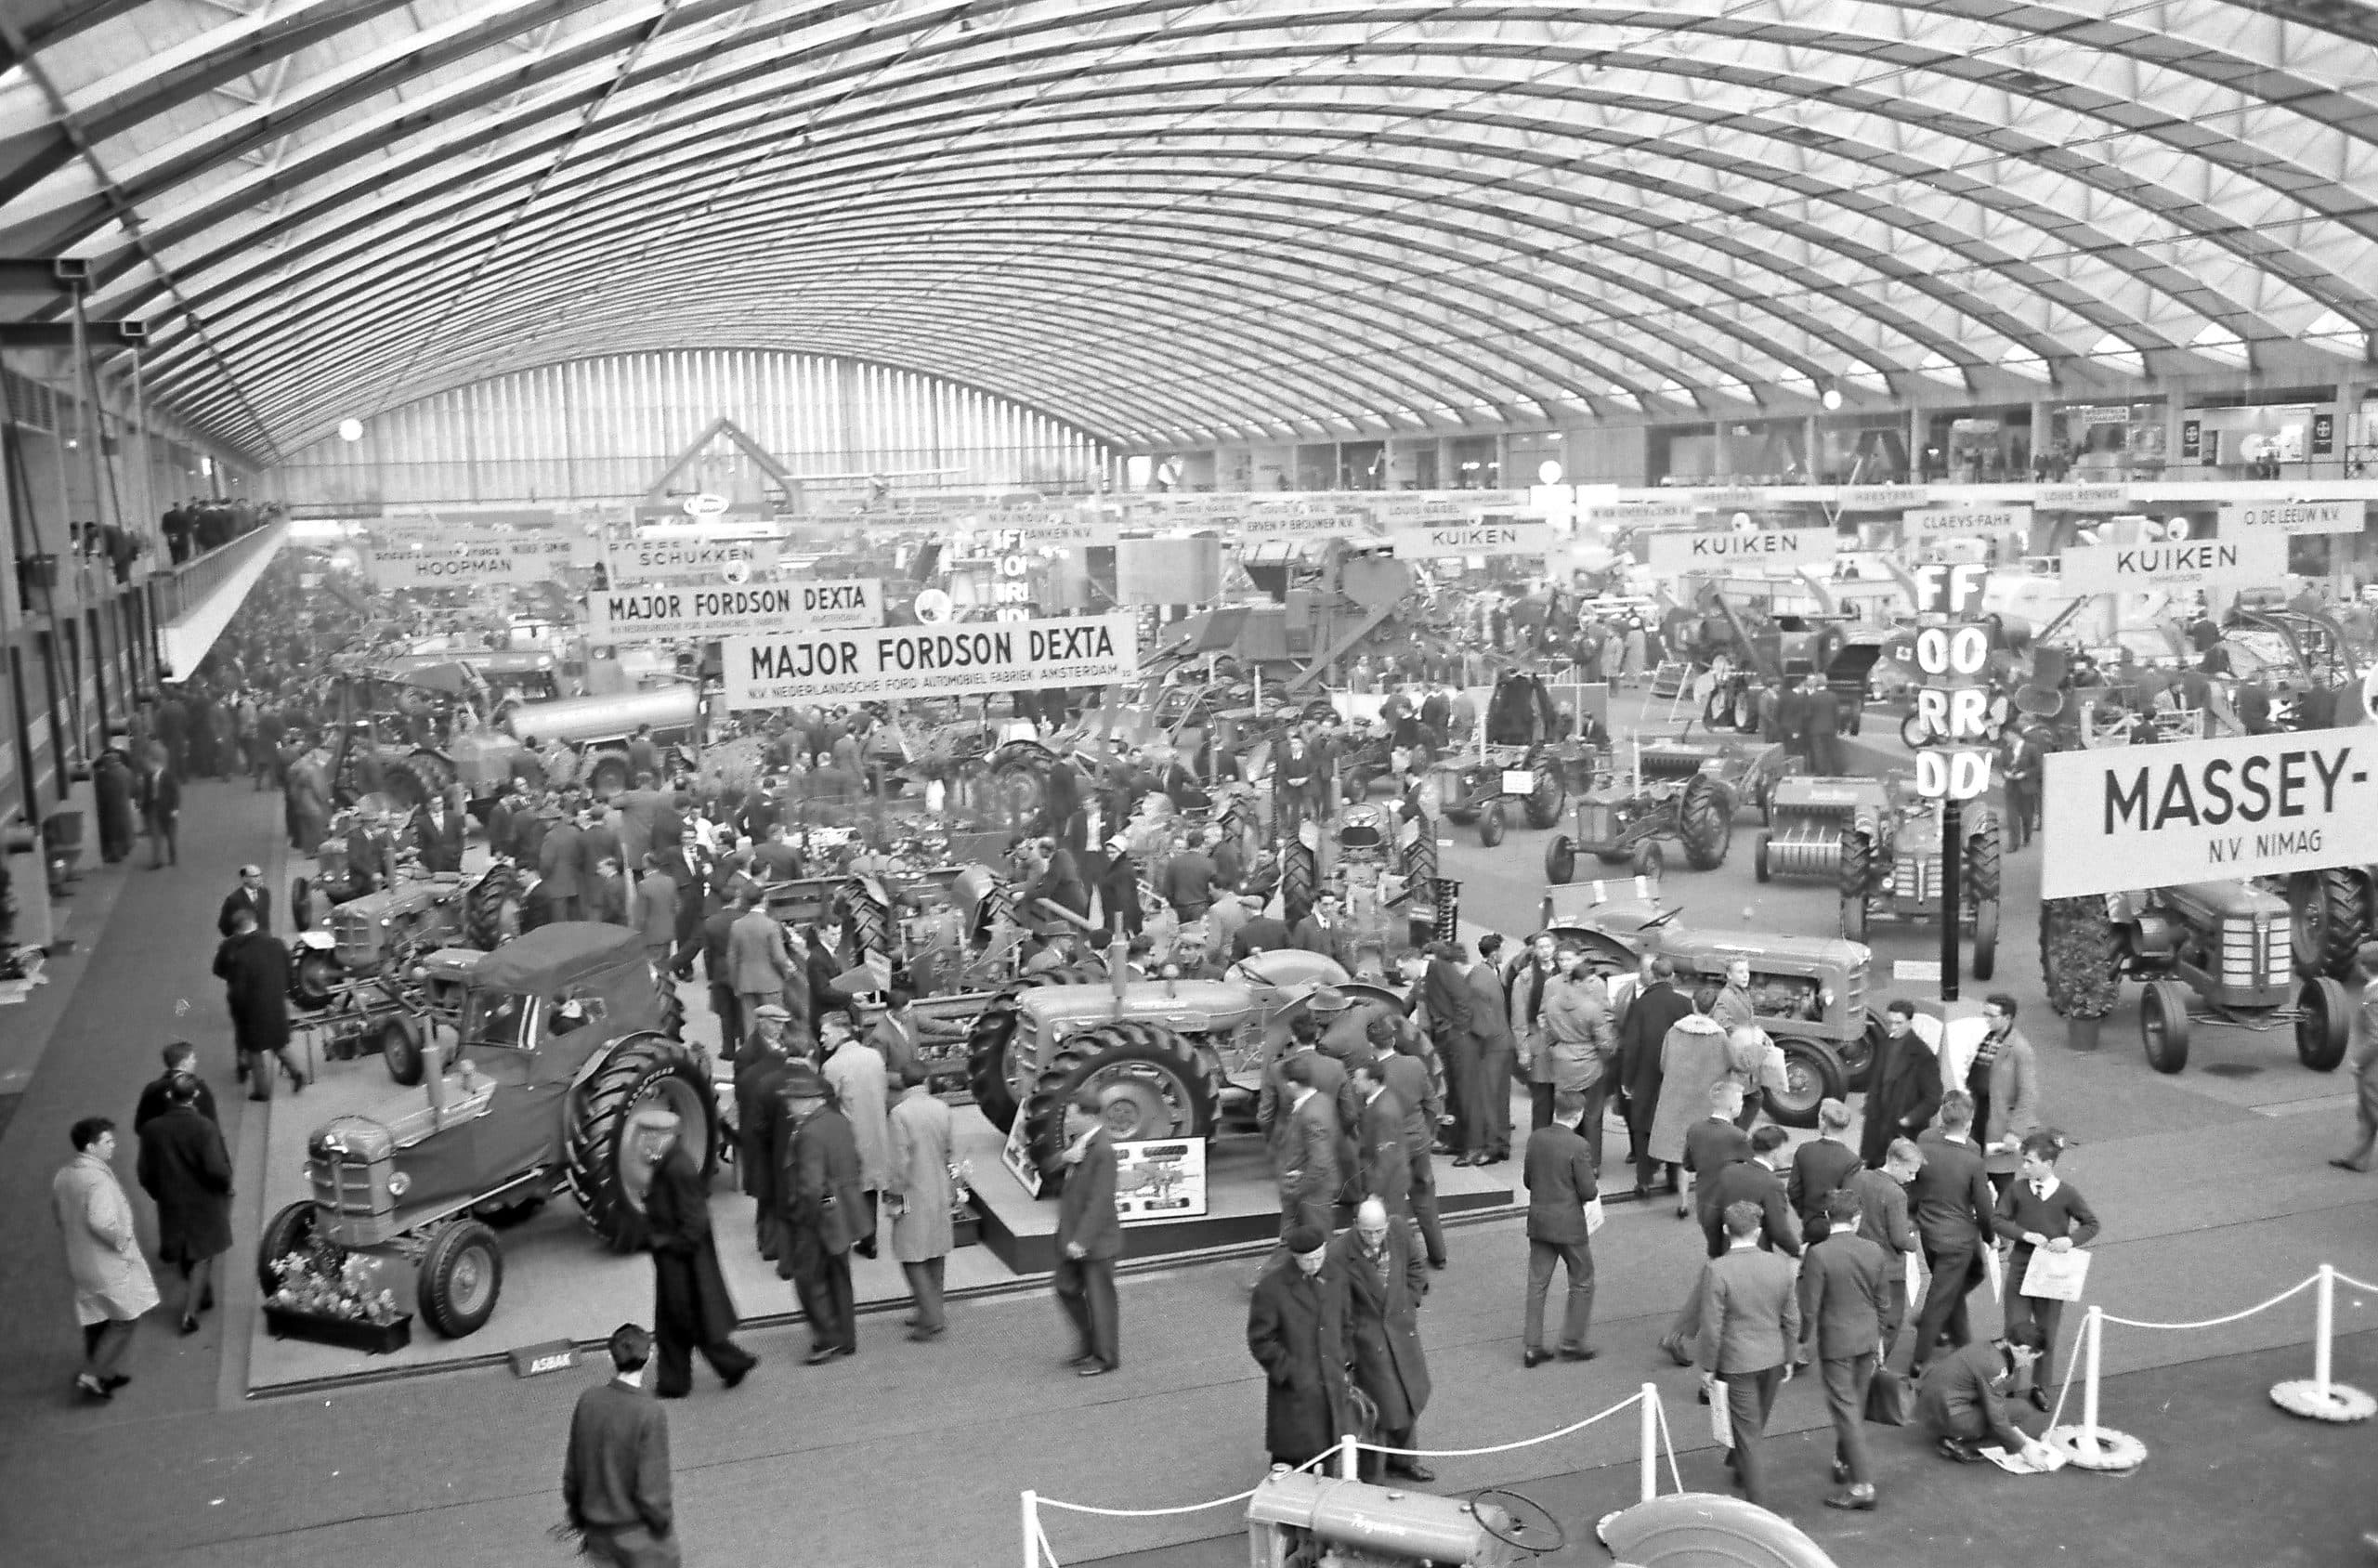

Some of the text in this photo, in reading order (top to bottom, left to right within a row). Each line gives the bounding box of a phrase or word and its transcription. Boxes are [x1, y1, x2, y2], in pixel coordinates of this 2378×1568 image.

[2261, 509, 2276, 524] DE
[2279, 508, 2316, 524] LEEUW
[1432, 529, 1516, 545] KUIKEN
[1692, 535, 1798, 555] KUIKEN
[416, 559, 512, 577] HOOPMAN
[639, 549, 755, 567] SCHUKKEN
[2117, 544, 2237, 573] KUIKEN
[609, 585, 867, 621] MAJOR FORDSON DEXTA
[751, 626, 1115, 680] MAJOR FORDSON DEXTA
[772, 679, 881, 698] NEDERLANDSCHE
[885, 676, 919, 690] FORD
[923, 673, 987, 688] AUTOMOBIEL
[990, 669, 1035, 684] FABRIEK
[1040, 663, 1118, 680] AMSTERDAM
[2255, 829, 2321, 858] NIMAG
